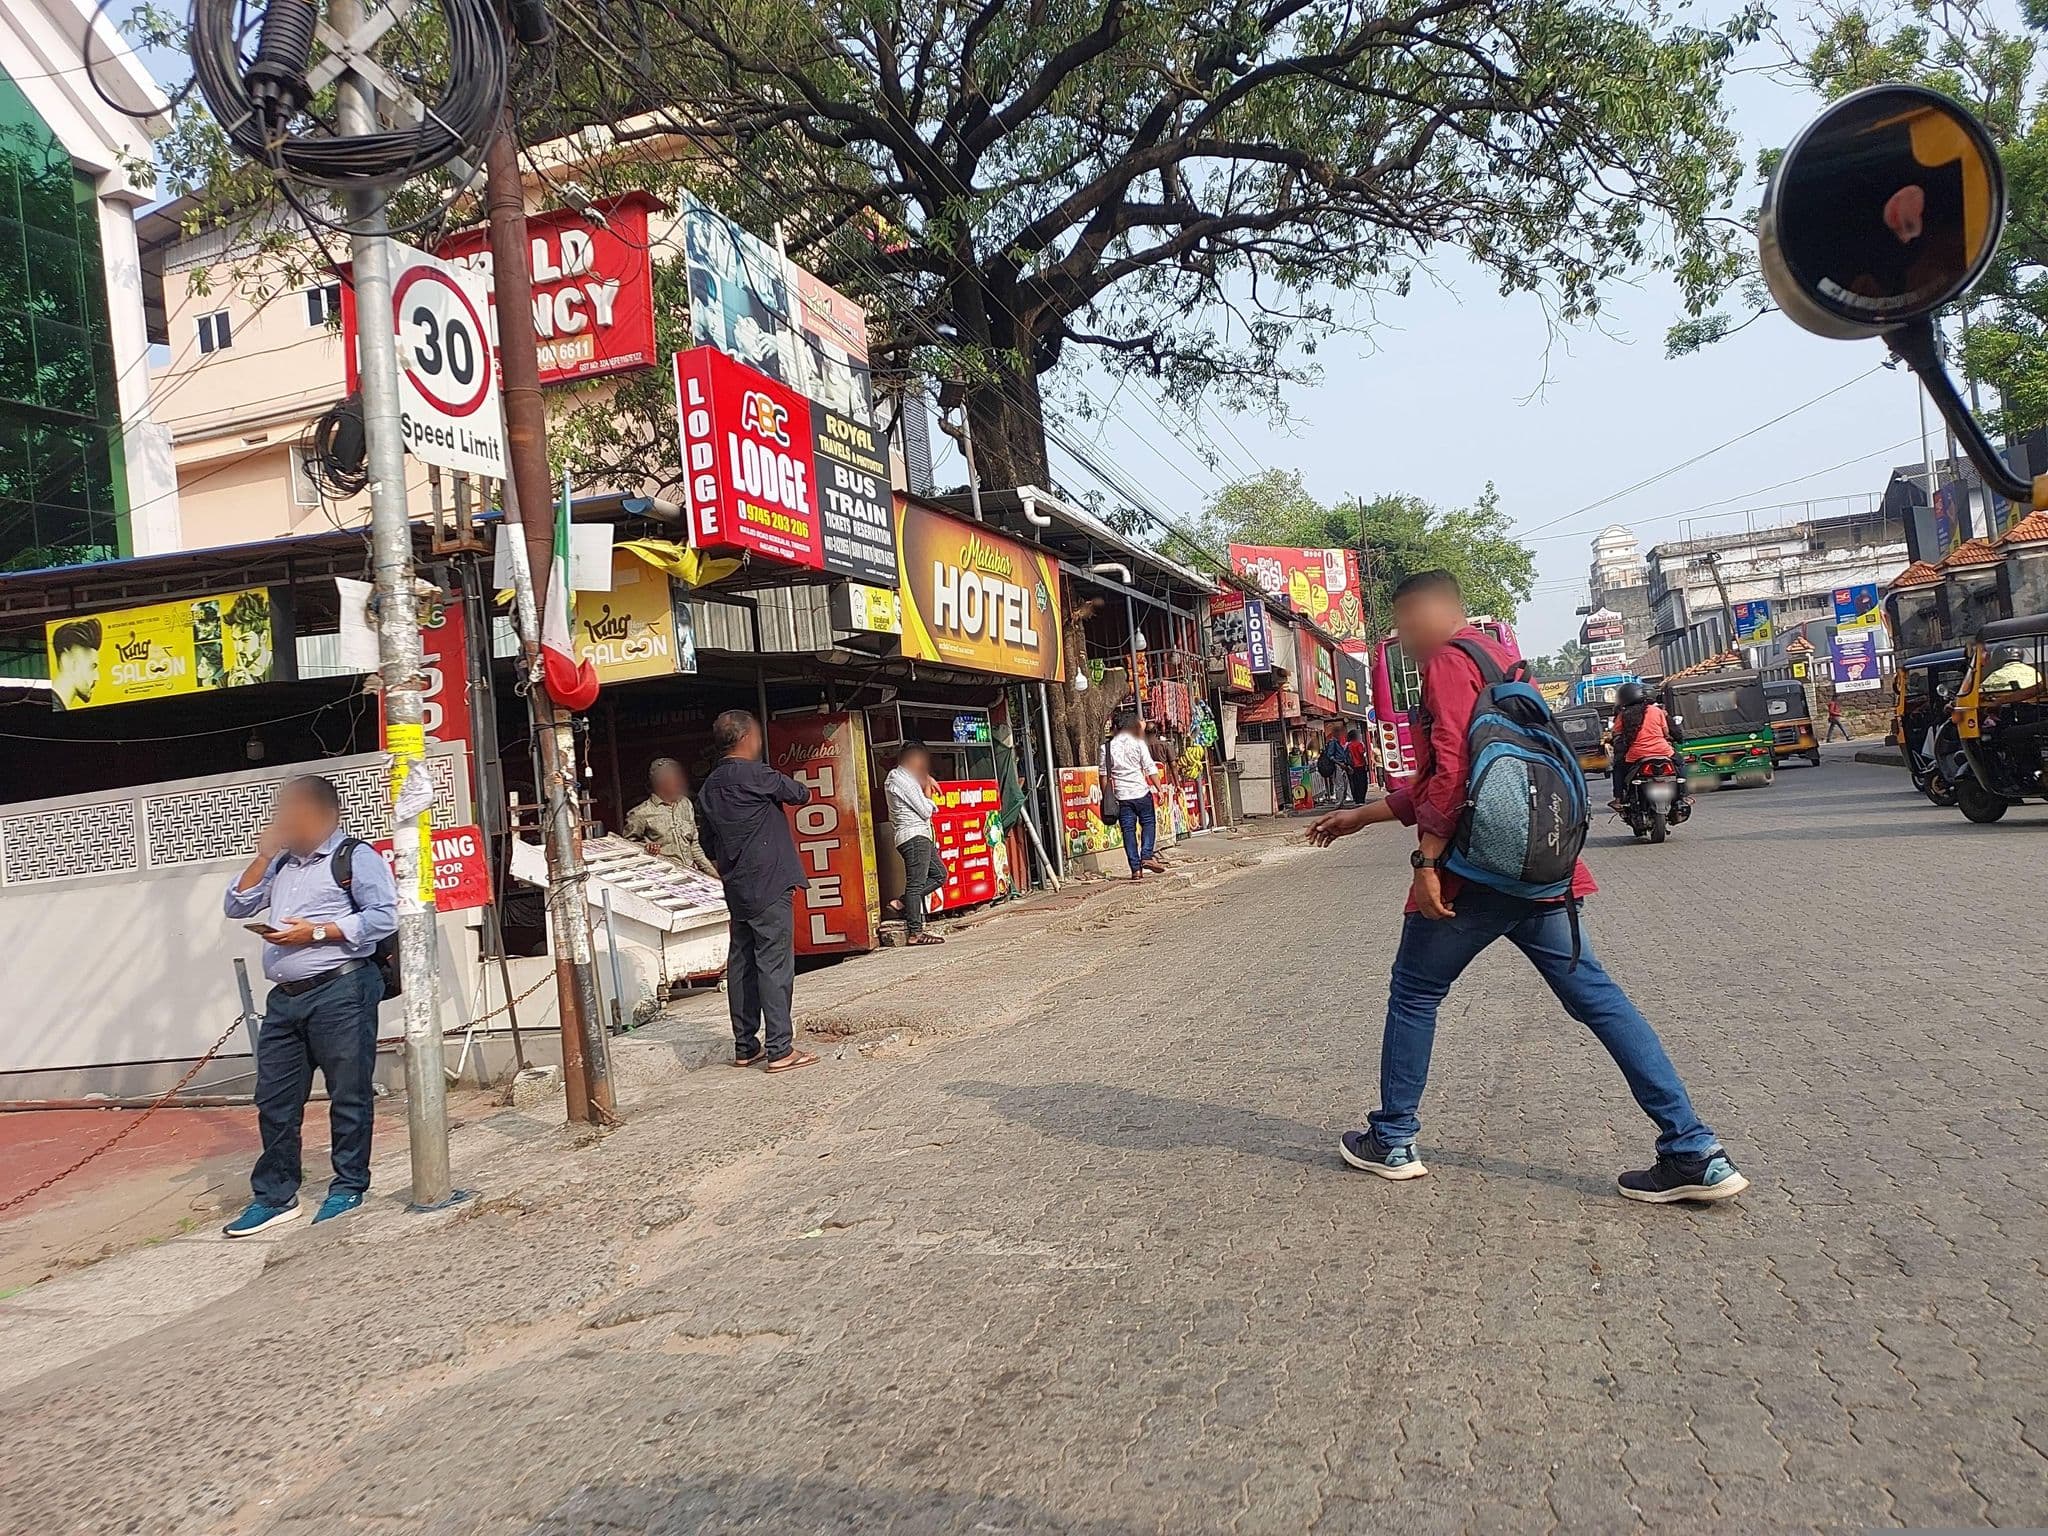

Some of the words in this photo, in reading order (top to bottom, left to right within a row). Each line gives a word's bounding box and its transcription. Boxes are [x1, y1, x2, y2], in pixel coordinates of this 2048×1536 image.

[413, 306, 474, 385] 30
[401, 412, 455, 450] Speed
[459, 427, 500, 462] Limit
[741, 390, 791, 448] ABC
[825, 413, 876, 453] ROYAL
[687, 377, 719, 536] LODGE
[818, 433, 851, 462] TRAVELS
[728, 431, 810, 515] LODGE
[834, 464, 877, 499] BUS
[746, 503, 771, 527] 9745
[771, 511, 790, 533] 203
[790, 518, 809, 539] 206
[825, 487, 888, 528] TRAIN
[824, 510, 852, 535] TICKETS
[852, 519, 892, 546] RESERVATION
[959, 532, 1013, 577] Malabar
[583, 604, 631, 643] King
[933, 560, 1038, 647] HOTEL
[115, 631, 151, 663] King
[581, 634, 668, 666] SALOON
[1249, 606, 1265, 668] LODGE
[111, 655, 187, 686] SALOON
[778, 742, 842, 766] Malabar
[435, 862, 463, 877] FOR
[793, 765, 847, 946] HOTEL
